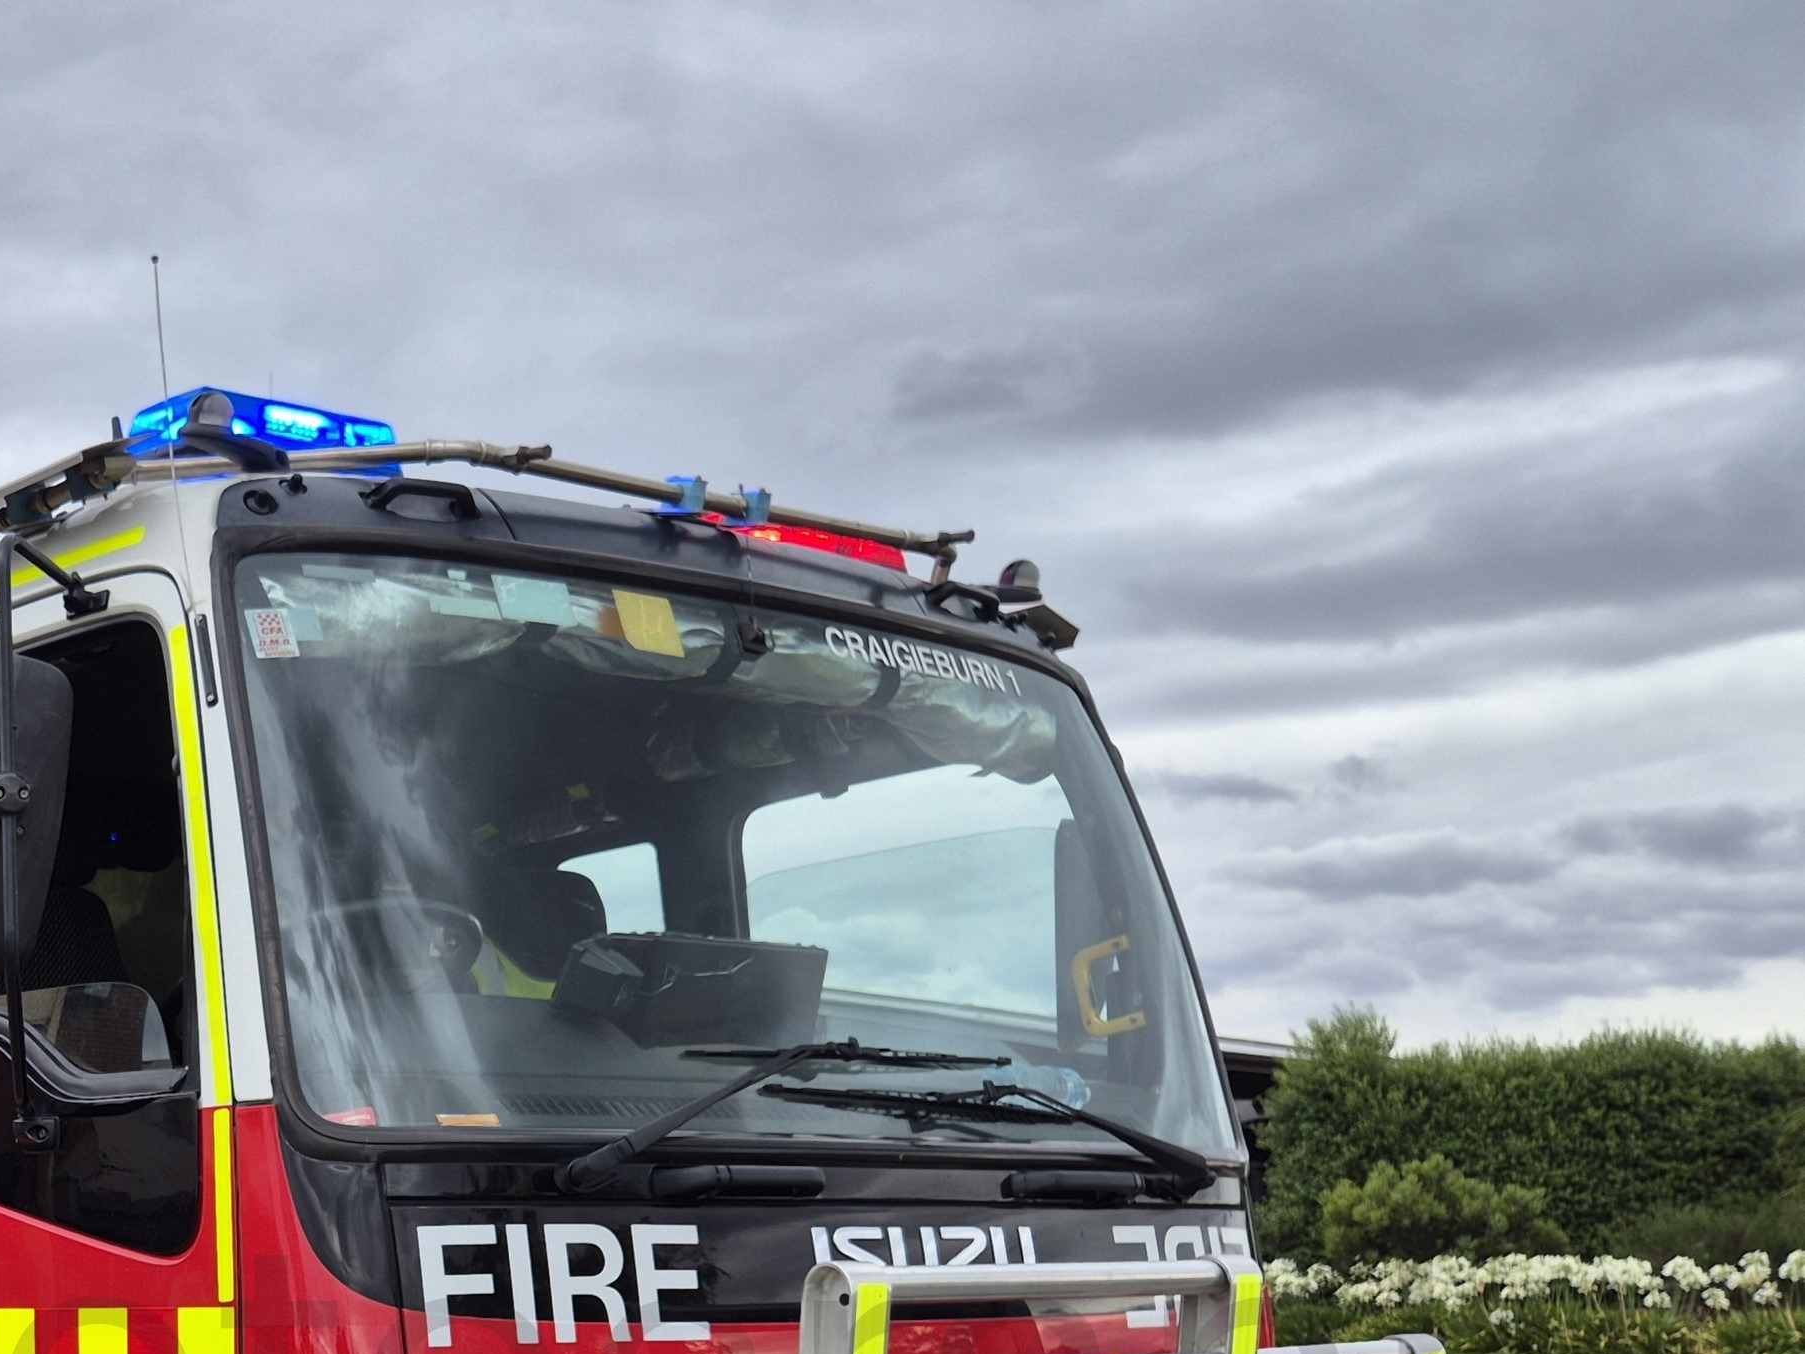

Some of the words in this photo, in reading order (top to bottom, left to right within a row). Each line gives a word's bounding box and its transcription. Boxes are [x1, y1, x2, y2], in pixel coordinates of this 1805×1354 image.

[824, 626, 1006, 694] CRAIGIEBURN
[1006, 669, 1023, 697] 1
[415, 1223, 712, 1348] FIRE
